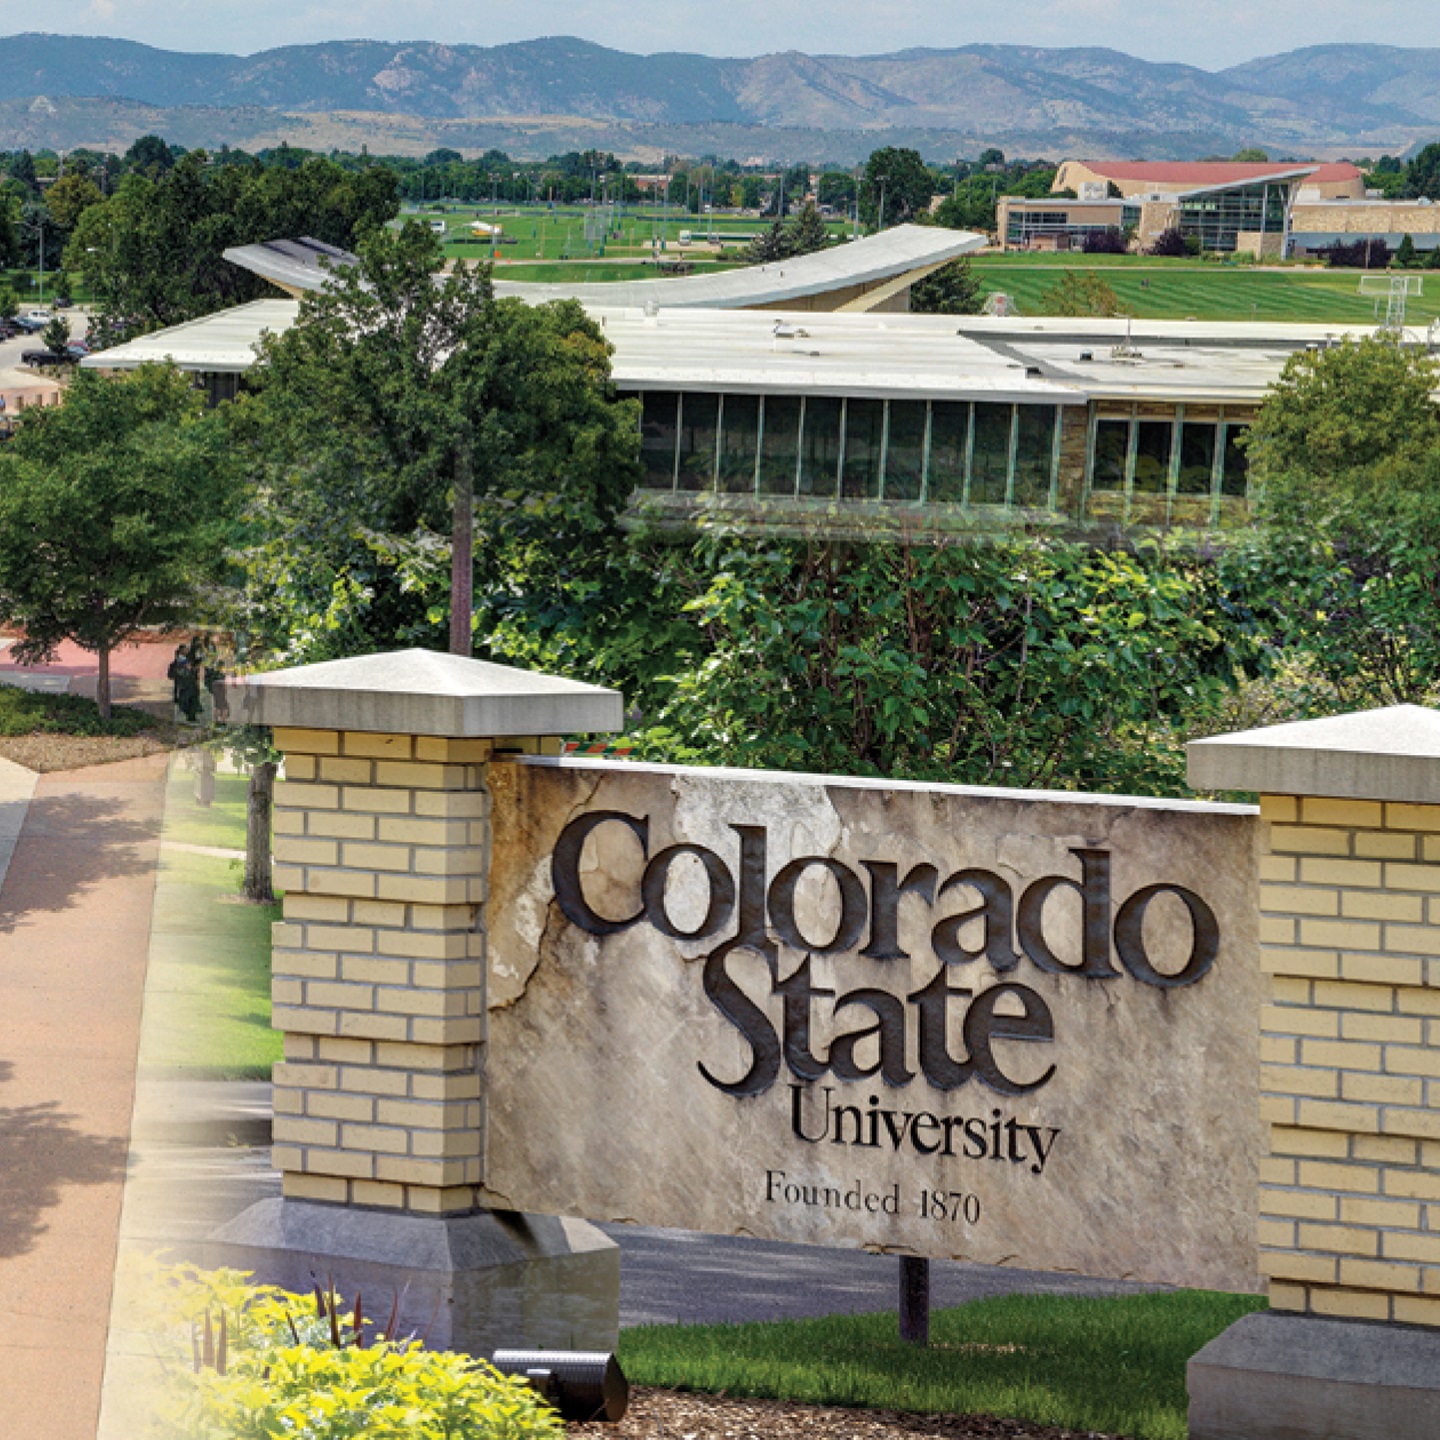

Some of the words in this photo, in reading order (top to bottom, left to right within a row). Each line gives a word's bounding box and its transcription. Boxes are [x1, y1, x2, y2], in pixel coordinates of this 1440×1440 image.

[553, 810, 1220, 988] Colorado
[698, 938, 1056, 1097] State
[789, 1083, 1061, 1174] University
[765, 1170, 901, 1215] Founded
[919, 1190, 981, 1225] 1870
